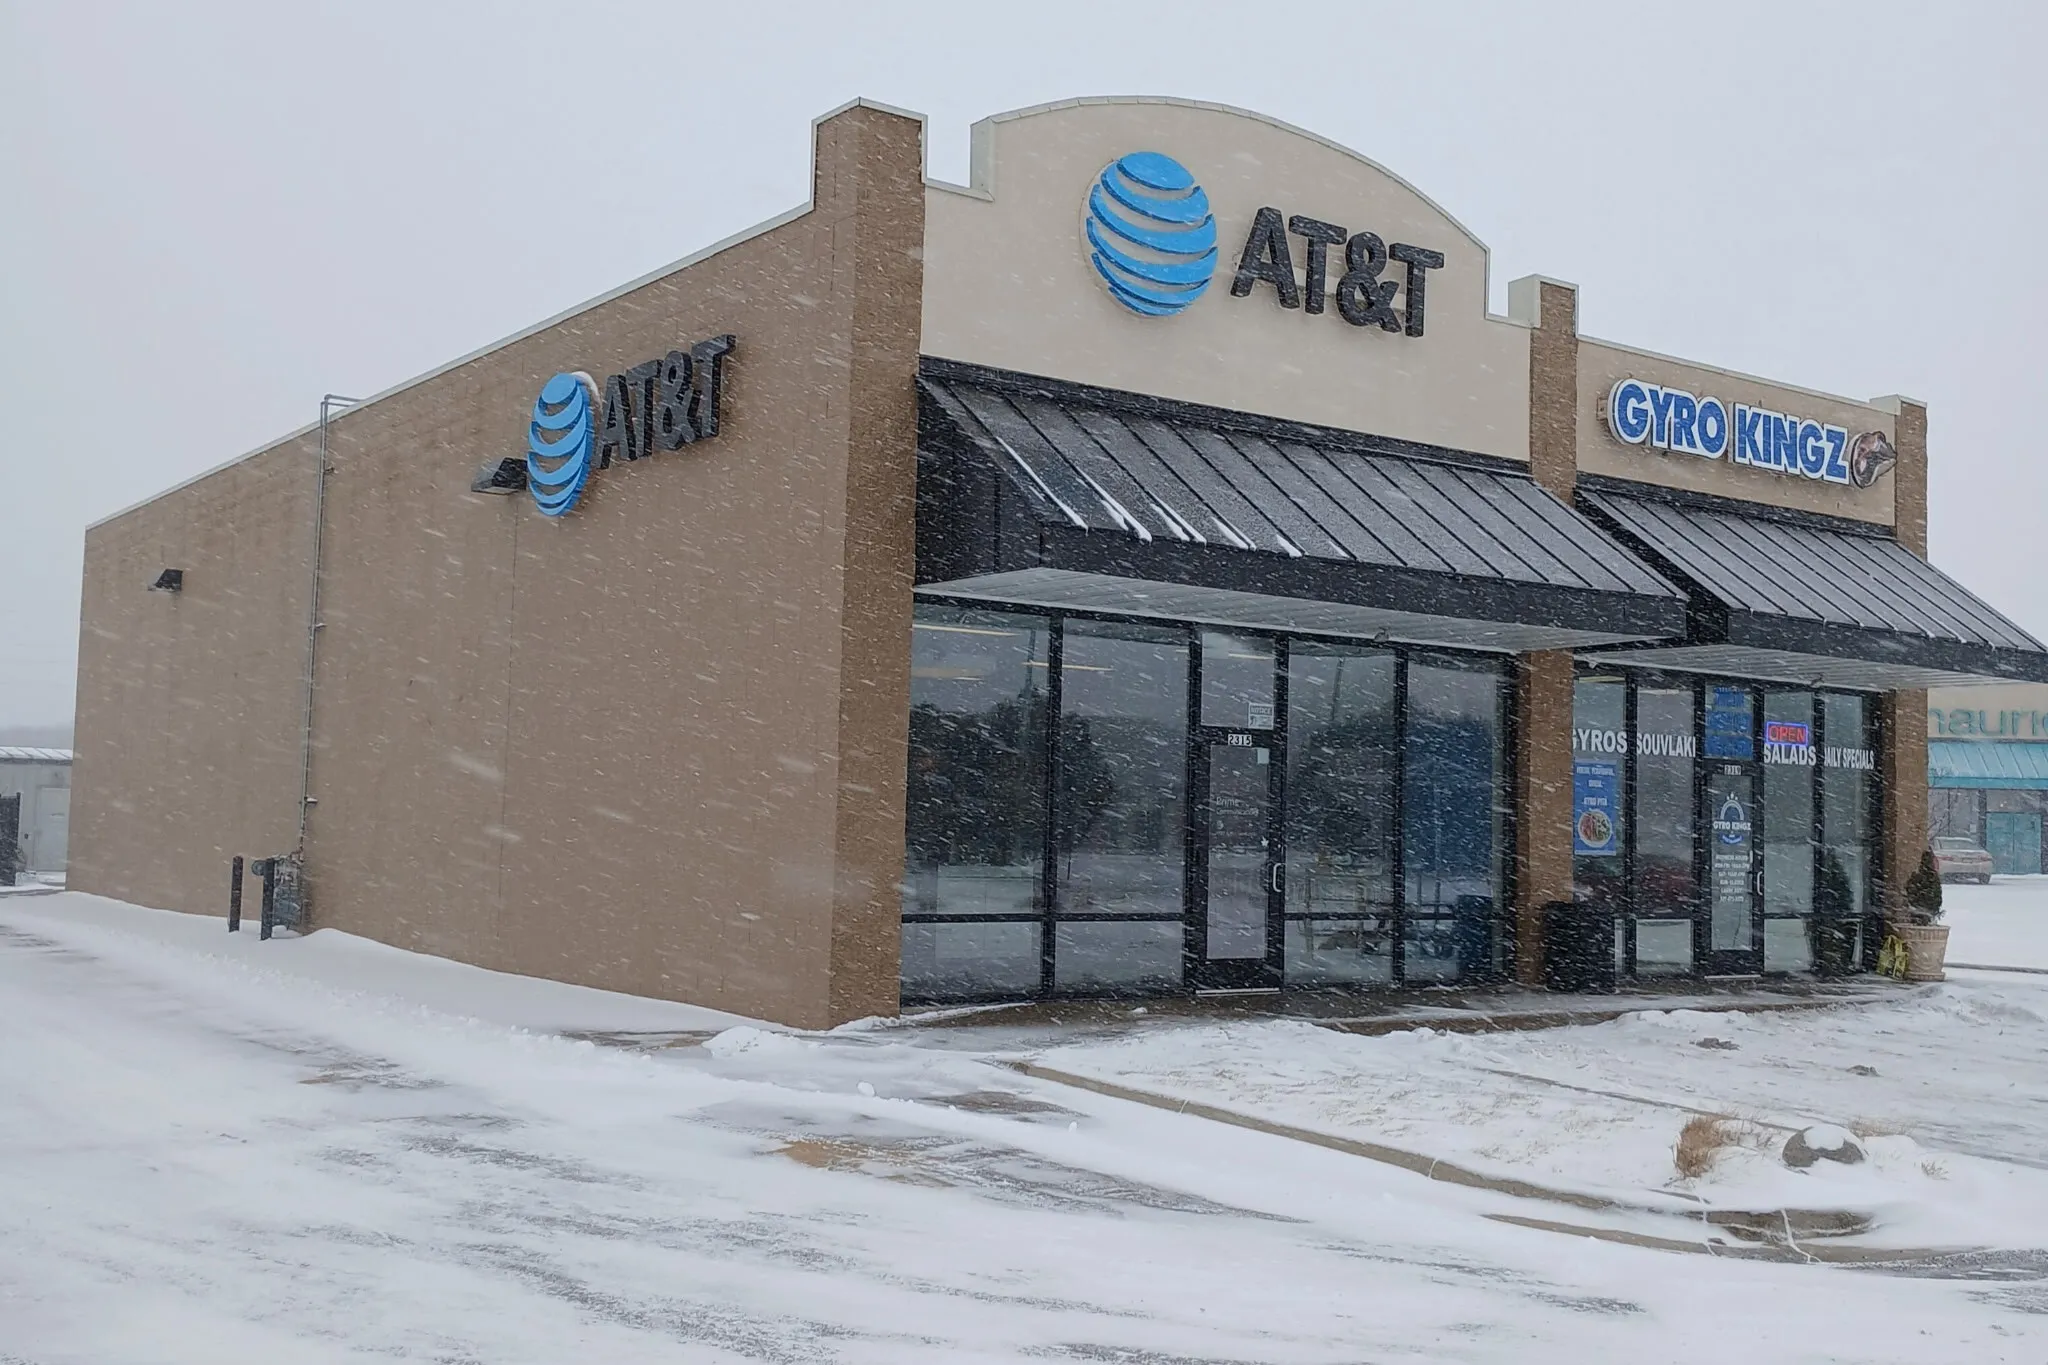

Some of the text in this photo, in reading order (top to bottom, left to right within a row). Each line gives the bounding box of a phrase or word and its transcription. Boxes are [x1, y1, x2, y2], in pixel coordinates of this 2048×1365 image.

[1230, 206, 1445, 338] AT&T
[590, 334, 737, 470] AT&T
[1611, 380, 1850, 485] GYRO KINGZ
[1229, 734, 1251, 745] 2315
[1636, 733, 1696, 758] SOUVLAKI
[1769, 725, 1805, 743] OPEN
[1763, 743, 1817, 766] SALADS
[1842, 747, 1875, 770] SPECIALS
